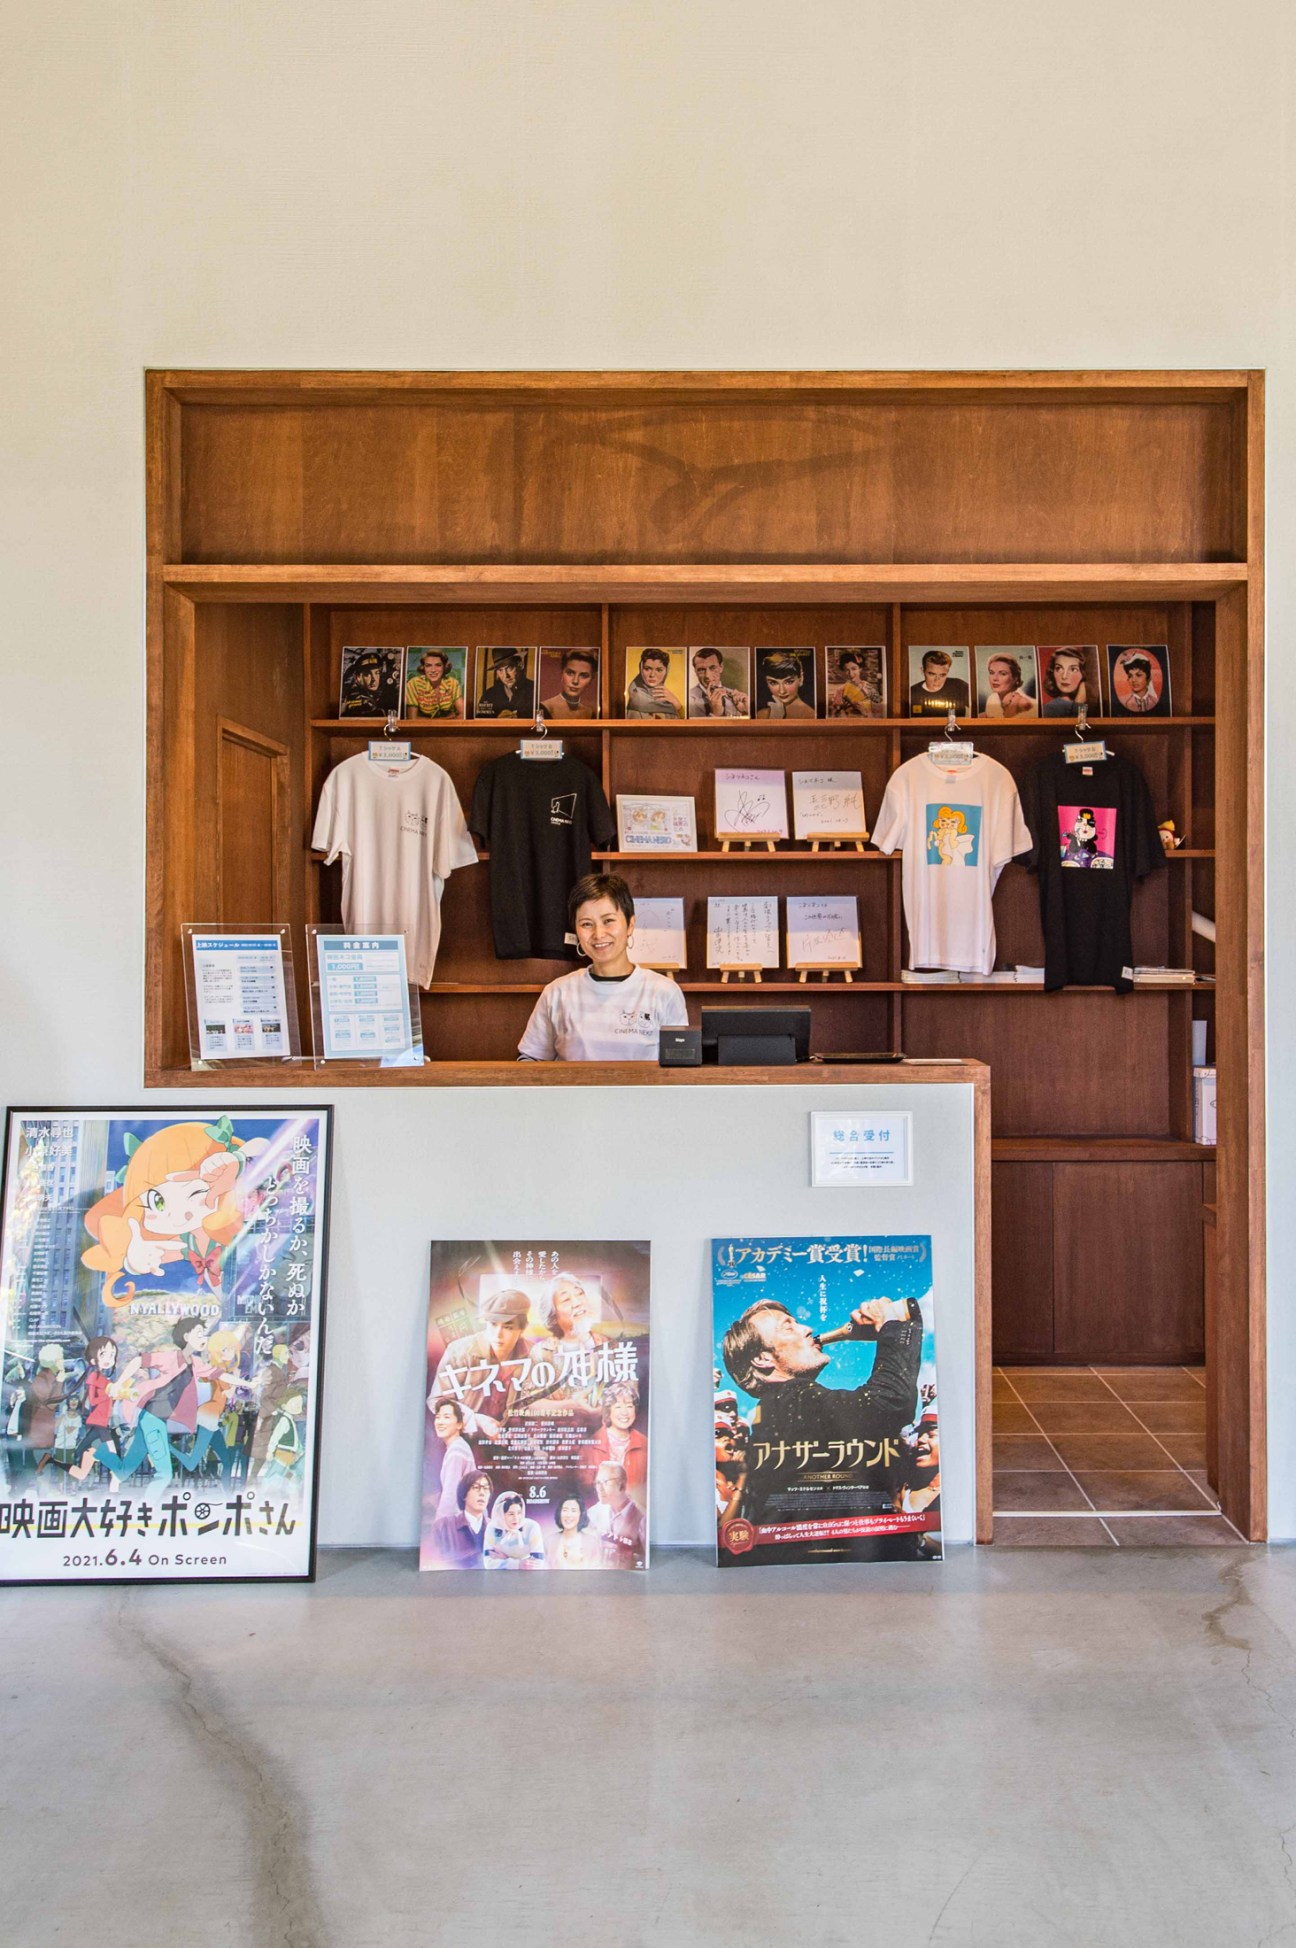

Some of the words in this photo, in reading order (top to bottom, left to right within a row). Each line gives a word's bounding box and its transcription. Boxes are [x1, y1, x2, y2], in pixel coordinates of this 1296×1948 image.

[286, 1134, 313, 1317] 映画を撮るか、死ぬか
[438, 1341, 640, 1400] キネマの神様
[752, 1437, 901, 1471] アナザーラウンド
[529, 1485, 547, 1499] 8.6
[62, 1549, 143, 1568] 2021.6.4
[148, 1554, 169, 1566] On
[174, 1553, 228, 1566] Screen
